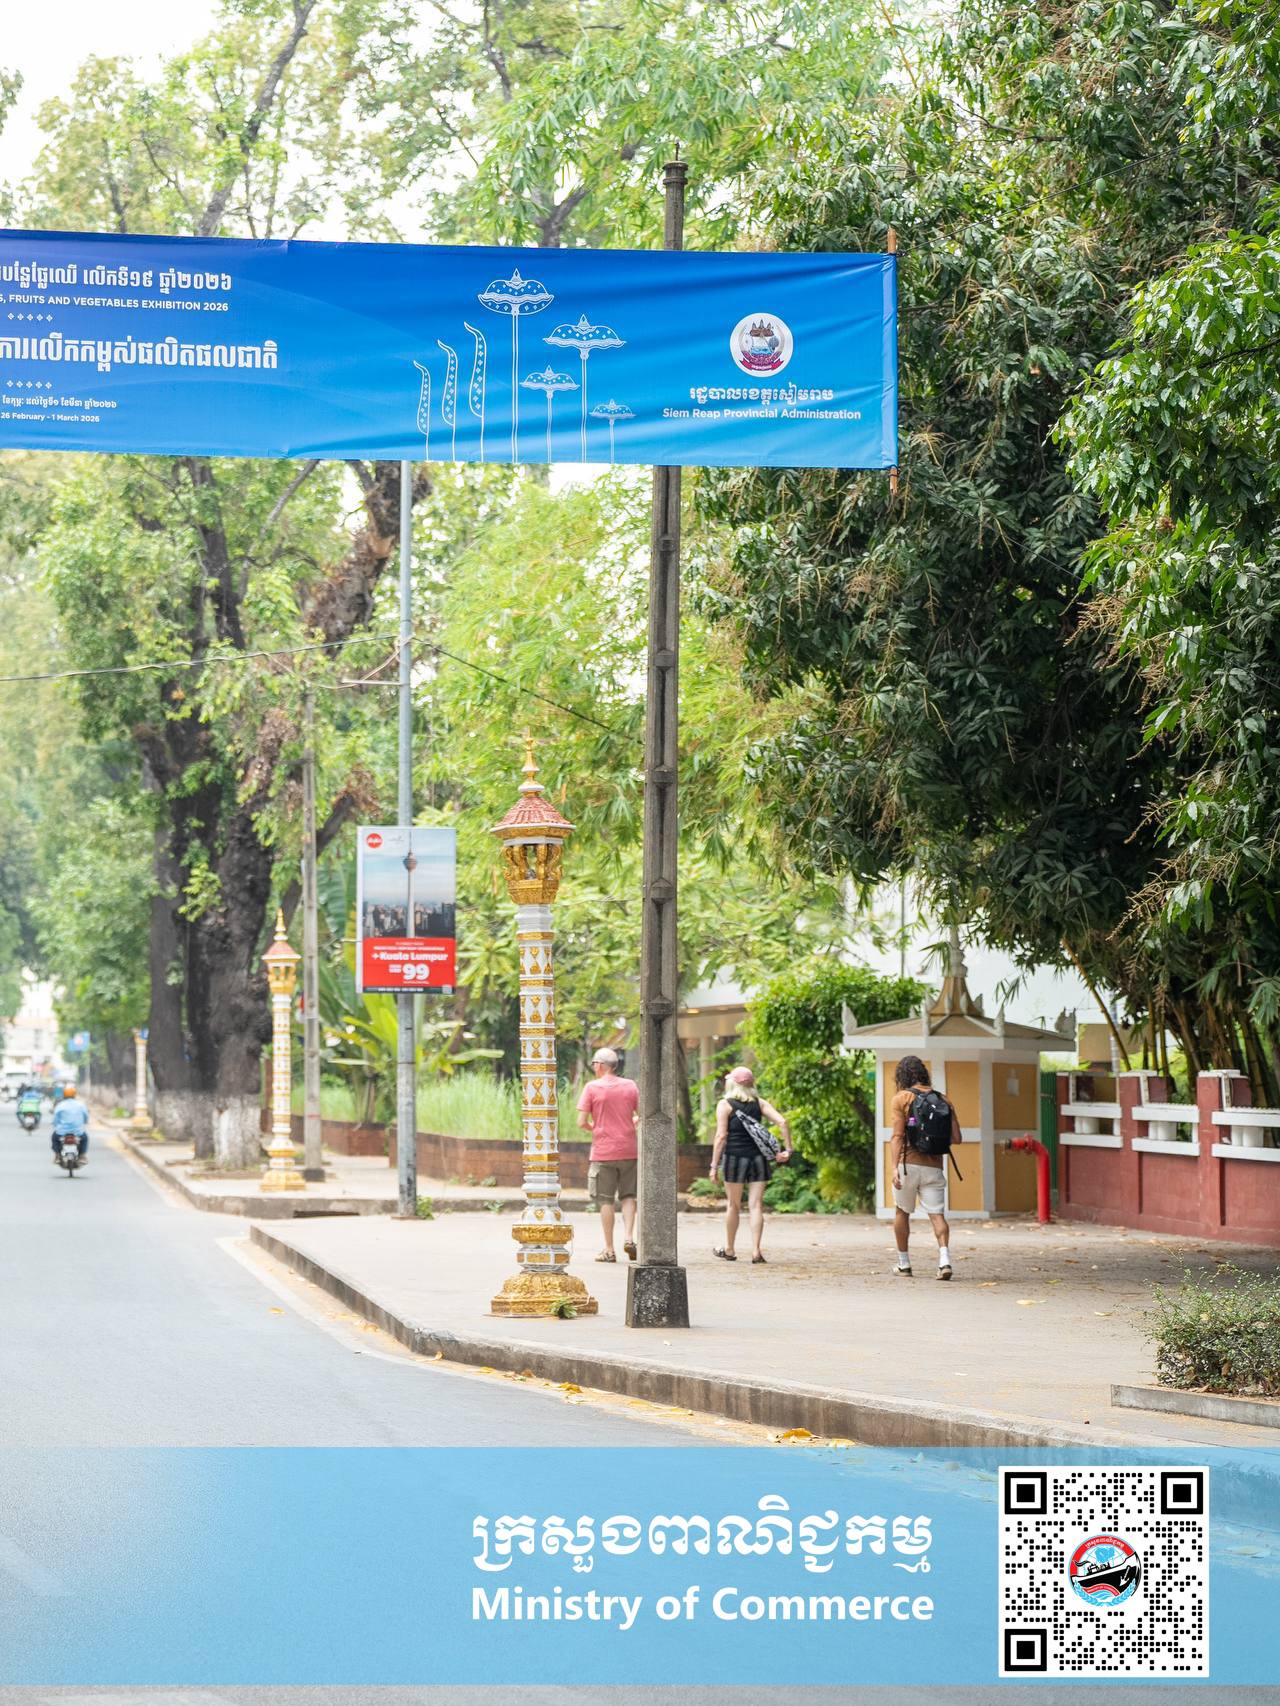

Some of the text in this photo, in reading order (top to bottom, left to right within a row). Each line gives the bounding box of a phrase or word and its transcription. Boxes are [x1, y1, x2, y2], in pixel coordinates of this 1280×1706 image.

[83, 265, 153, 288] លើកទី១៩
[159, 267, 232, 295] ឆ្នាំ២០២៦
[9, 294, 45, 304] FRUITS
[47, 296, 70, 305] AND
[73, 297, 139, 308] VEGETABLES
[141, 300, 201, 311] EXHIBITION
[203, 302, 229, 312] 2026
[689, 382, 834, 406] រដ្ឋបាលខេត្តសៀមរាប
[1, 411, 11, 419] 26
[12, 412, 45, 421] February
[56, 414, 79, 422] March
[80, 415, 100, 423] 2026
[663, 408, 861, 420] Siem Reap Provincial Administration
[380, 952, 448, 962] Kuala Lumpur
[402, 963, 430, 981] 99
